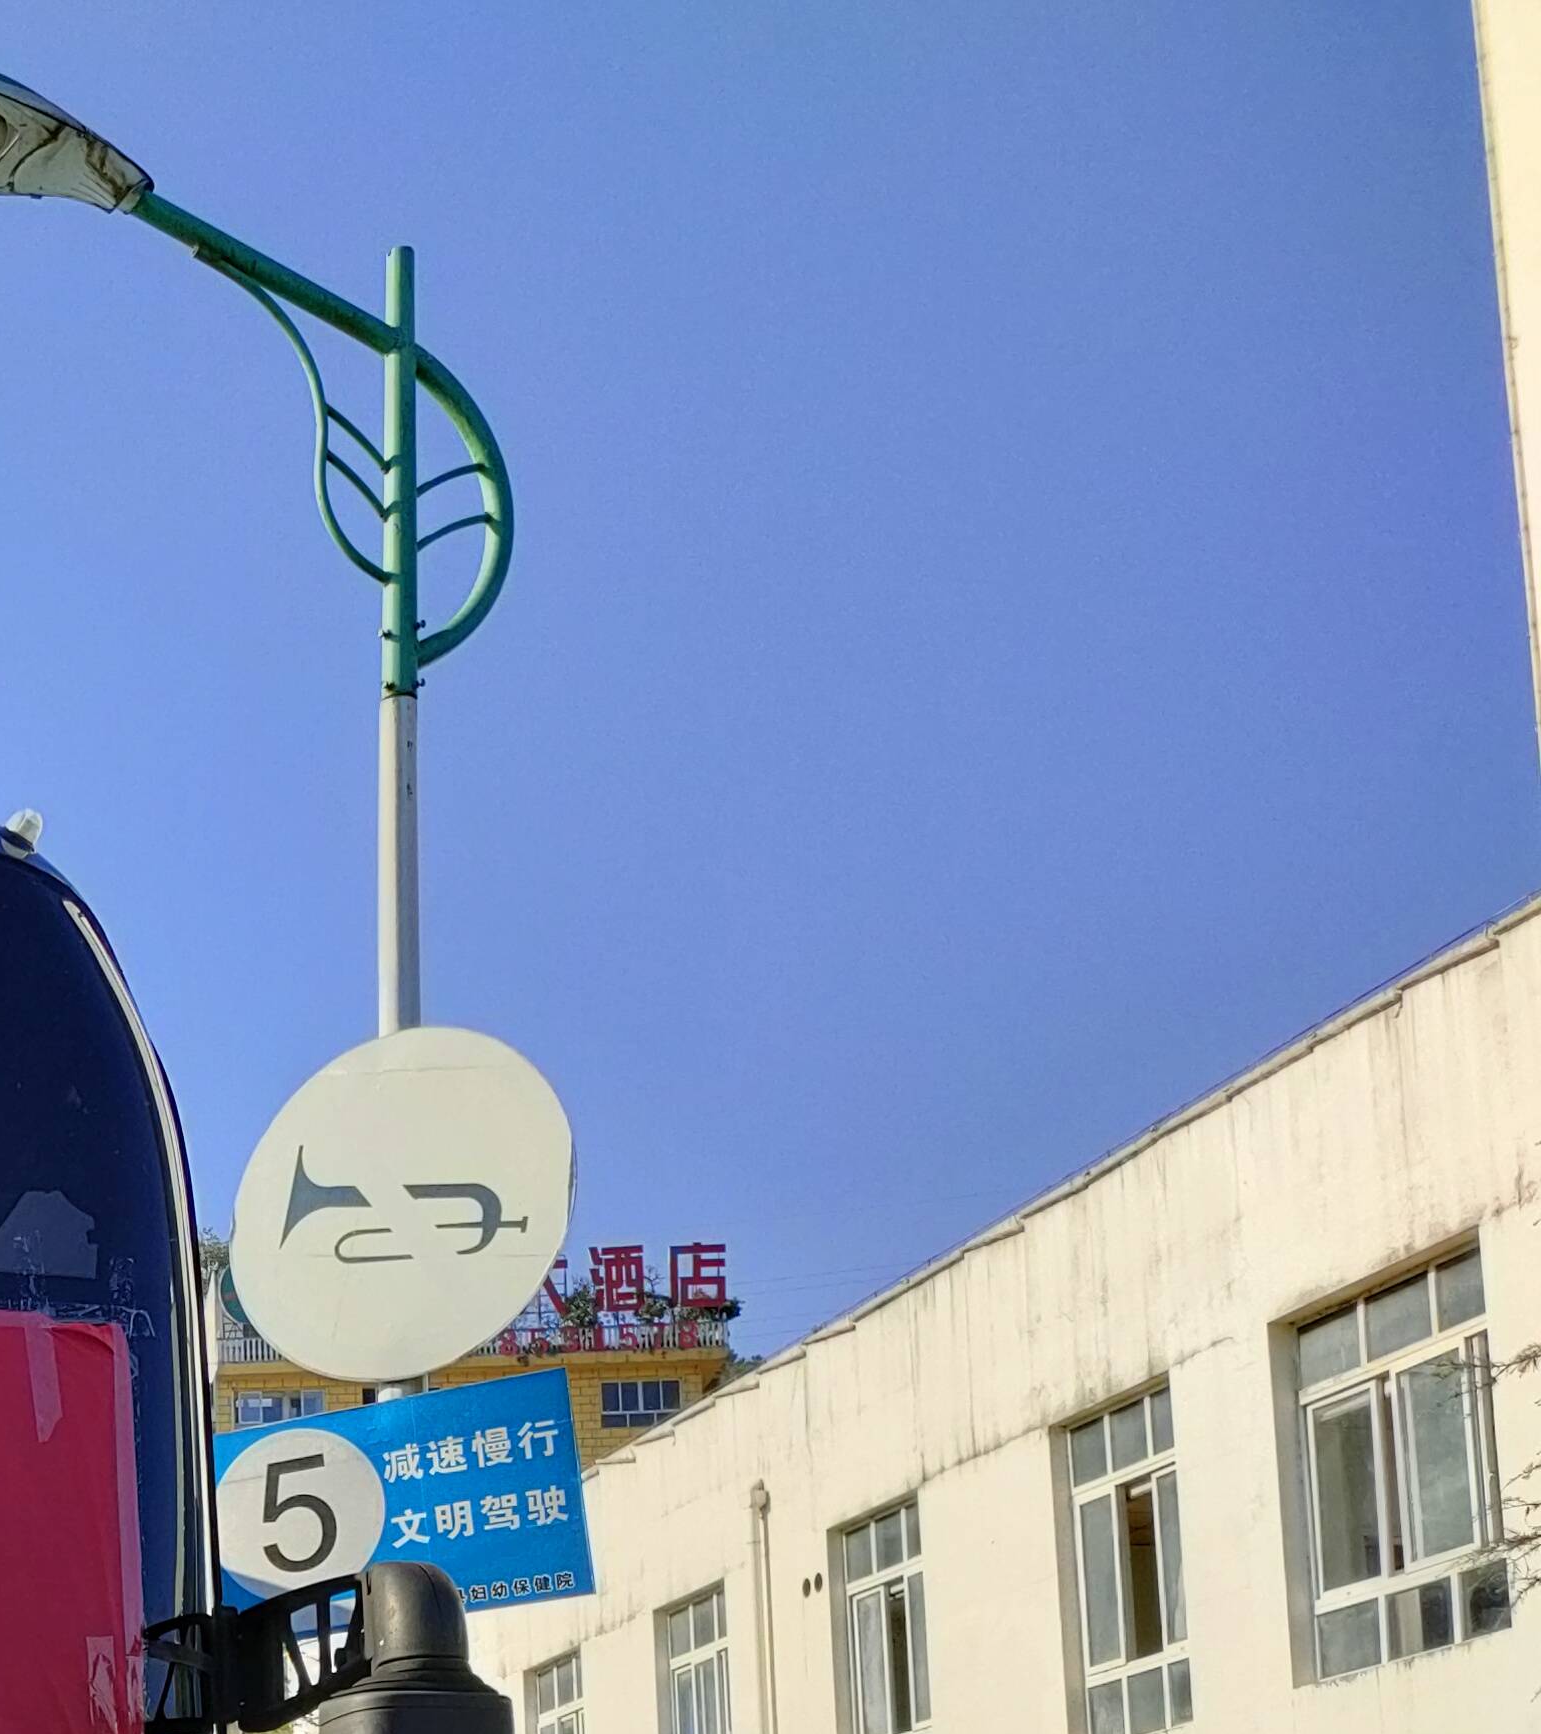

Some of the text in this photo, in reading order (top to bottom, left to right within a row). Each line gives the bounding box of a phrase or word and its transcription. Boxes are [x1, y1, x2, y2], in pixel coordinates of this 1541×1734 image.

[382, 1419, 560, 1484] 减速慢行
[262, 1453, 337, 1573] 5
[391, 1485, 570, 1549] 文明驾驶
